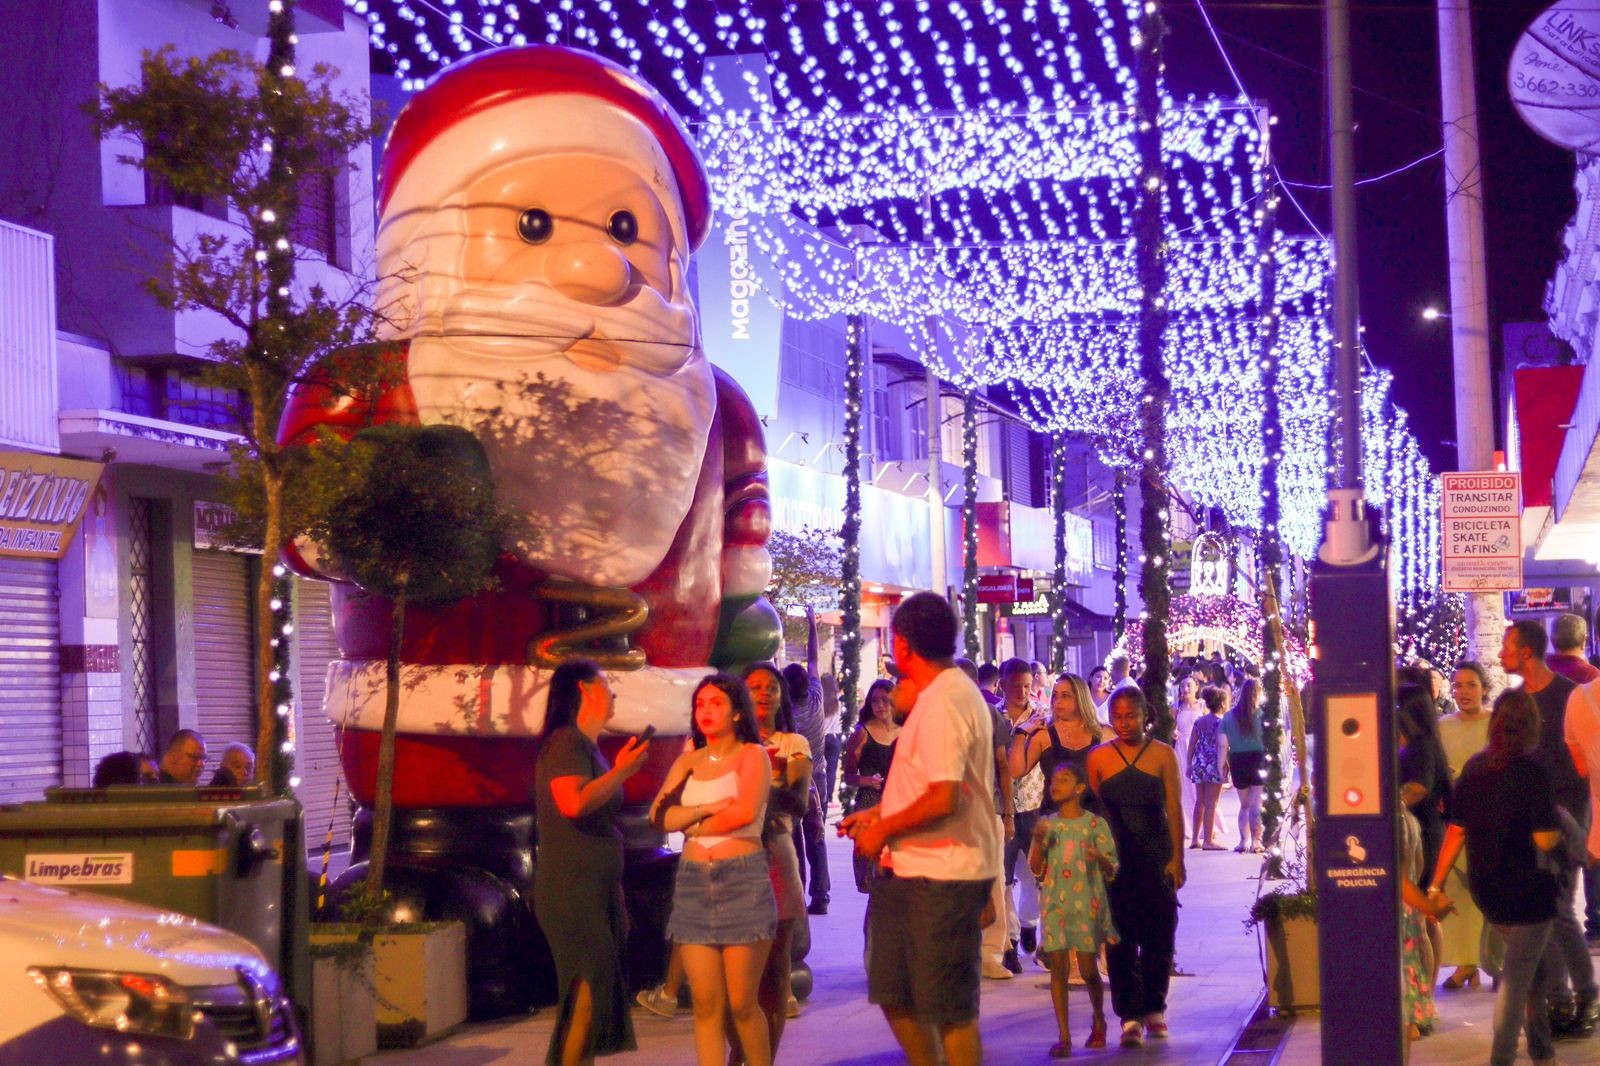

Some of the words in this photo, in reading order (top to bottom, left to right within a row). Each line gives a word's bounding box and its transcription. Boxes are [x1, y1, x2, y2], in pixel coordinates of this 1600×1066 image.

[1513, 71, 1600, 98] 3662-330
[1449, 477, 1513, 489] PROIBIDO
[1449, 492, 1513, 503] TRANSITAR
[1452, 505, 1511, 514] CONDUZINDO
[1452, 520, 1511, 531] BICICLETA
[11, 528, 61, 553] INFANTIL
[1452, 532, 1488, 543] SKATE
[1453, 544, 1460, 554] E
[1463, 544, 1498, 554] AFINS
[29, 856, 123, 880] Limpebras
[1327, 867, 1386, 877] EMERGÊNCIA
[1337, 878, 1377, 887] POLICIAL
